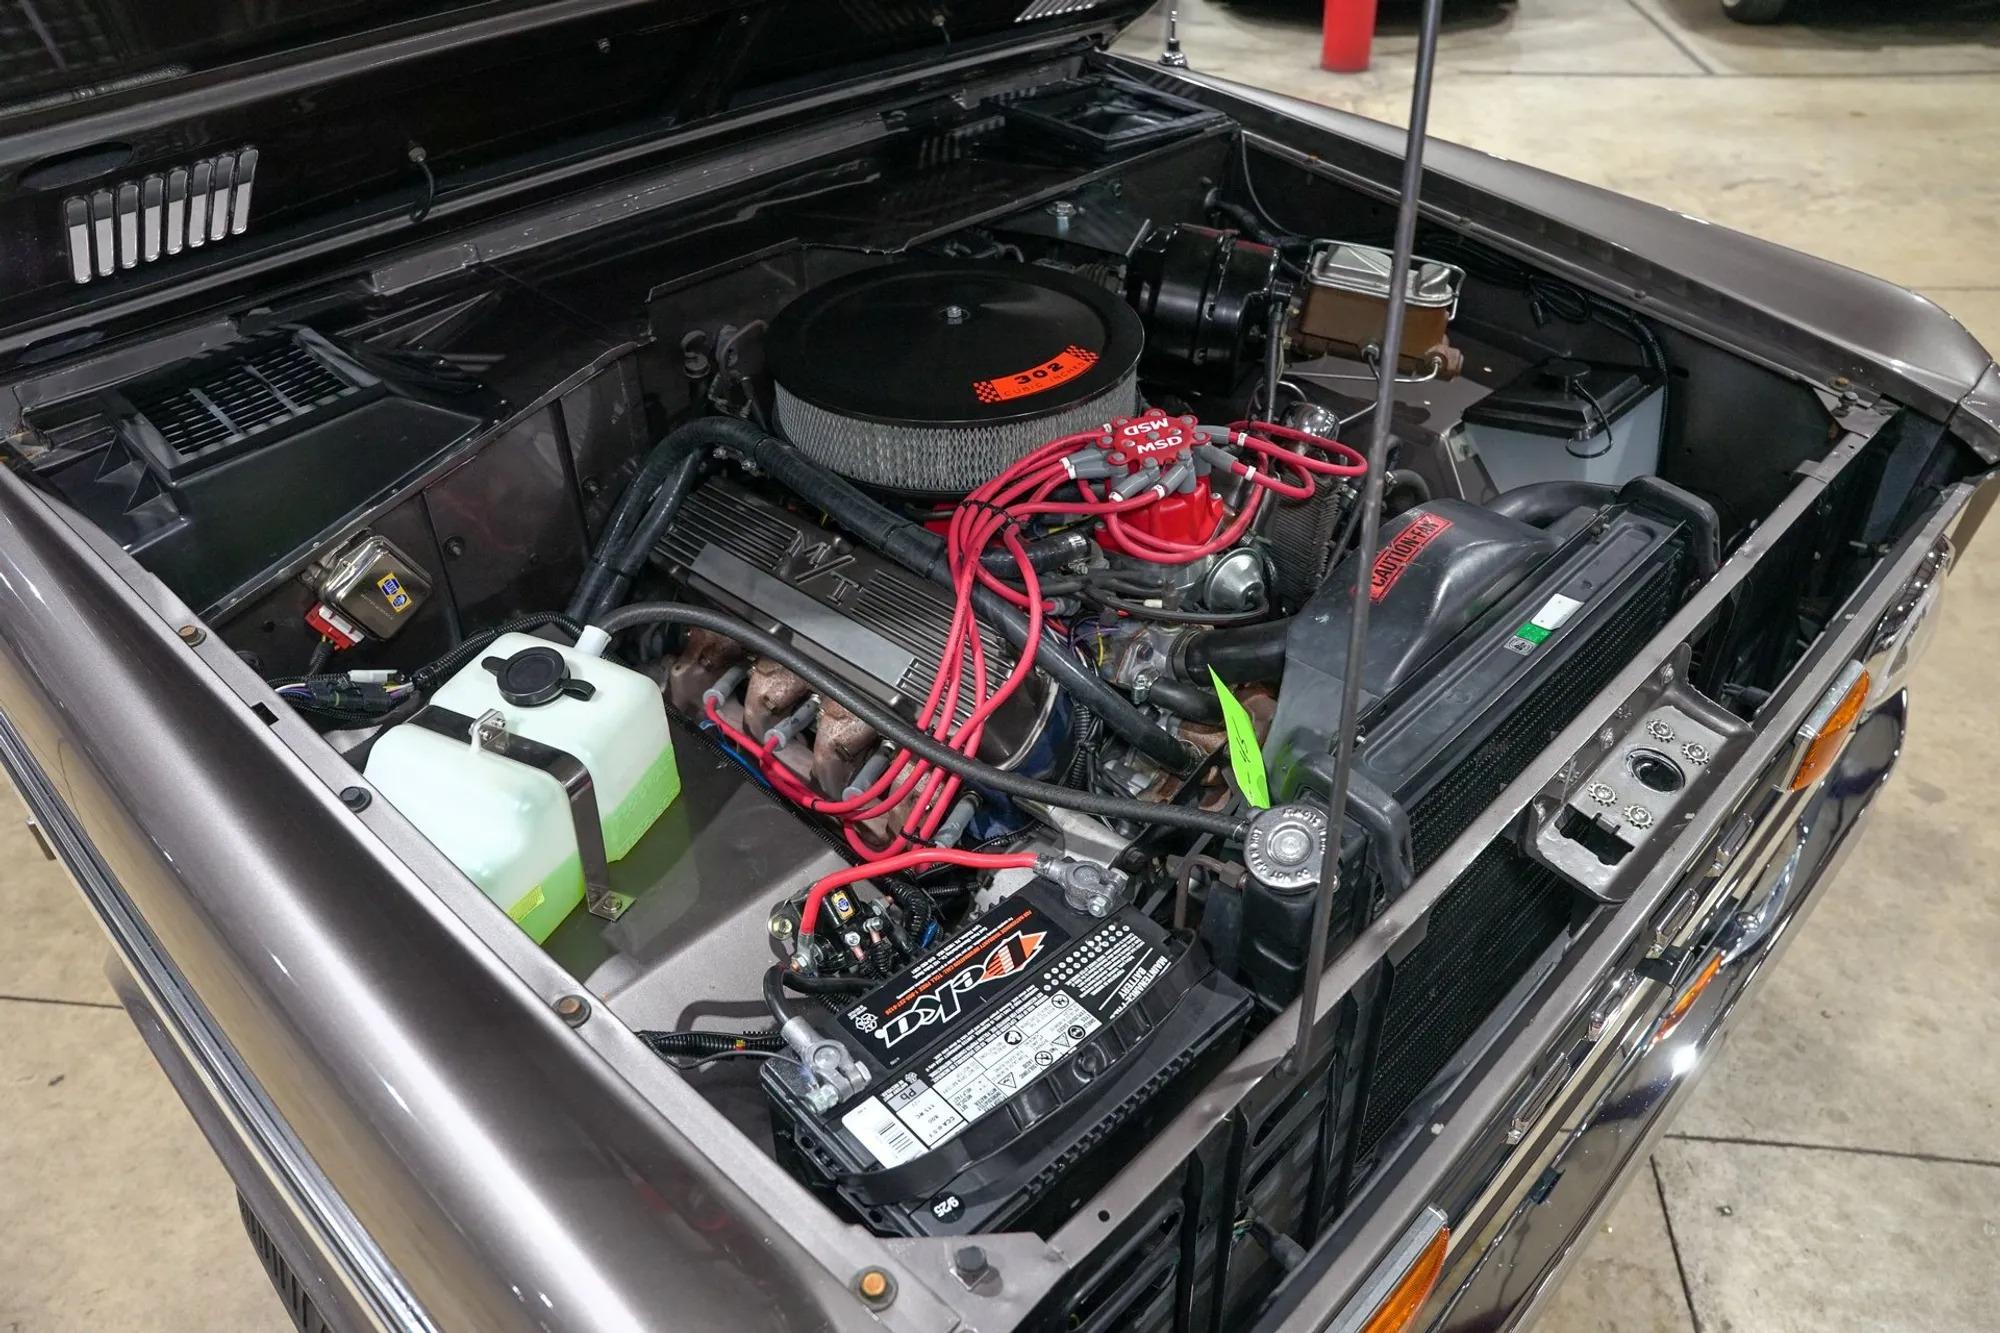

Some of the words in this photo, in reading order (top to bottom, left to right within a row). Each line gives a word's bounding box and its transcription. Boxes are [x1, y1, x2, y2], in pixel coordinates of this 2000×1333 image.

[1017, 363, 1063, 385] 302
[1004, 382, 1045, 397] CUBIC
[1123, 417, 1169, 436] MSD
[1137, 436, 1183, 455] MSD
[876, 931, 1047, 1048] Deka
[1117, 966, 1146, 998] BATTERY
[899, 1087, 916, 1102] Pb
[934, 1195, 960, 1219] 9/25
